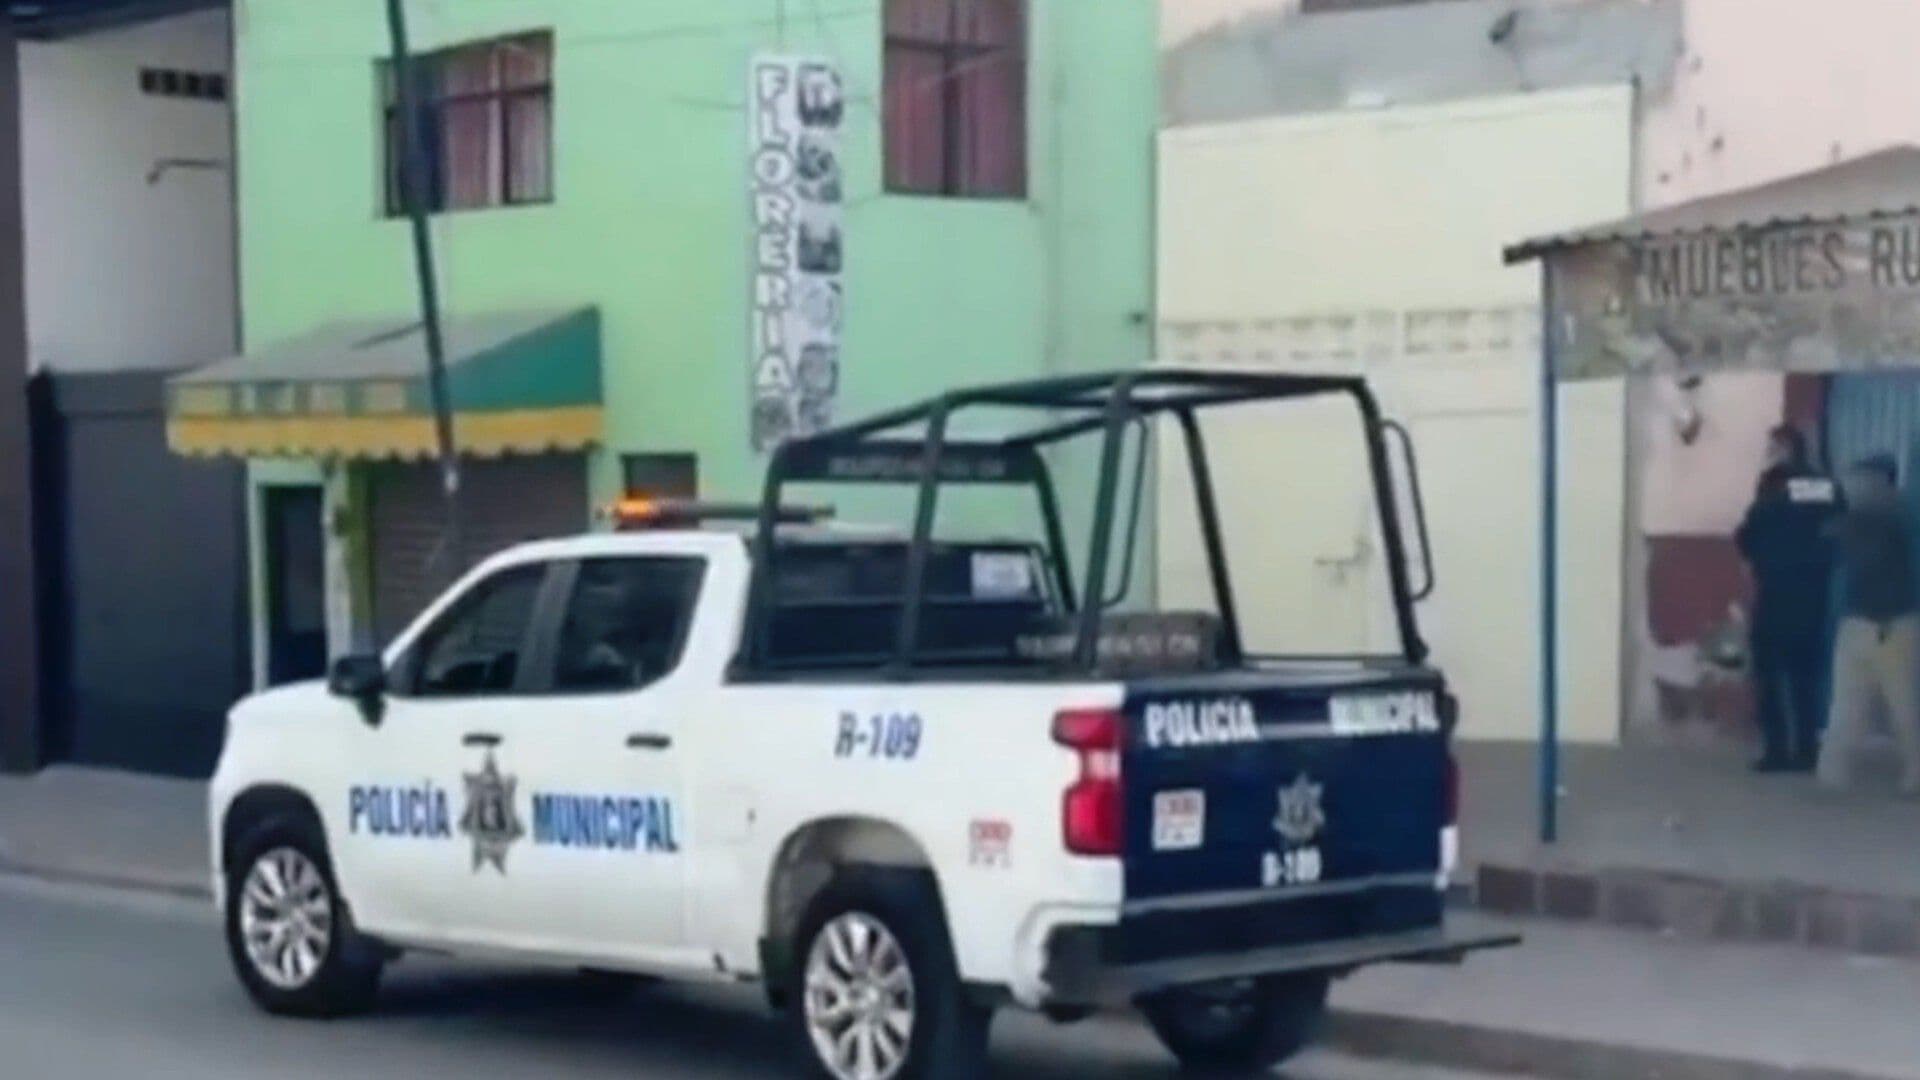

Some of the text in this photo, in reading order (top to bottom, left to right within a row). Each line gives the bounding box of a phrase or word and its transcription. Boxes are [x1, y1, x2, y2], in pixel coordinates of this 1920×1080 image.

[1648, 231, 1846, 298] MUEBLES
[834, 711, 922, 758] R-109
[1146, 696, 1259, 748] POLICÍA
[350, 778, 678, 853] POLICÍA MUNICIPAL
